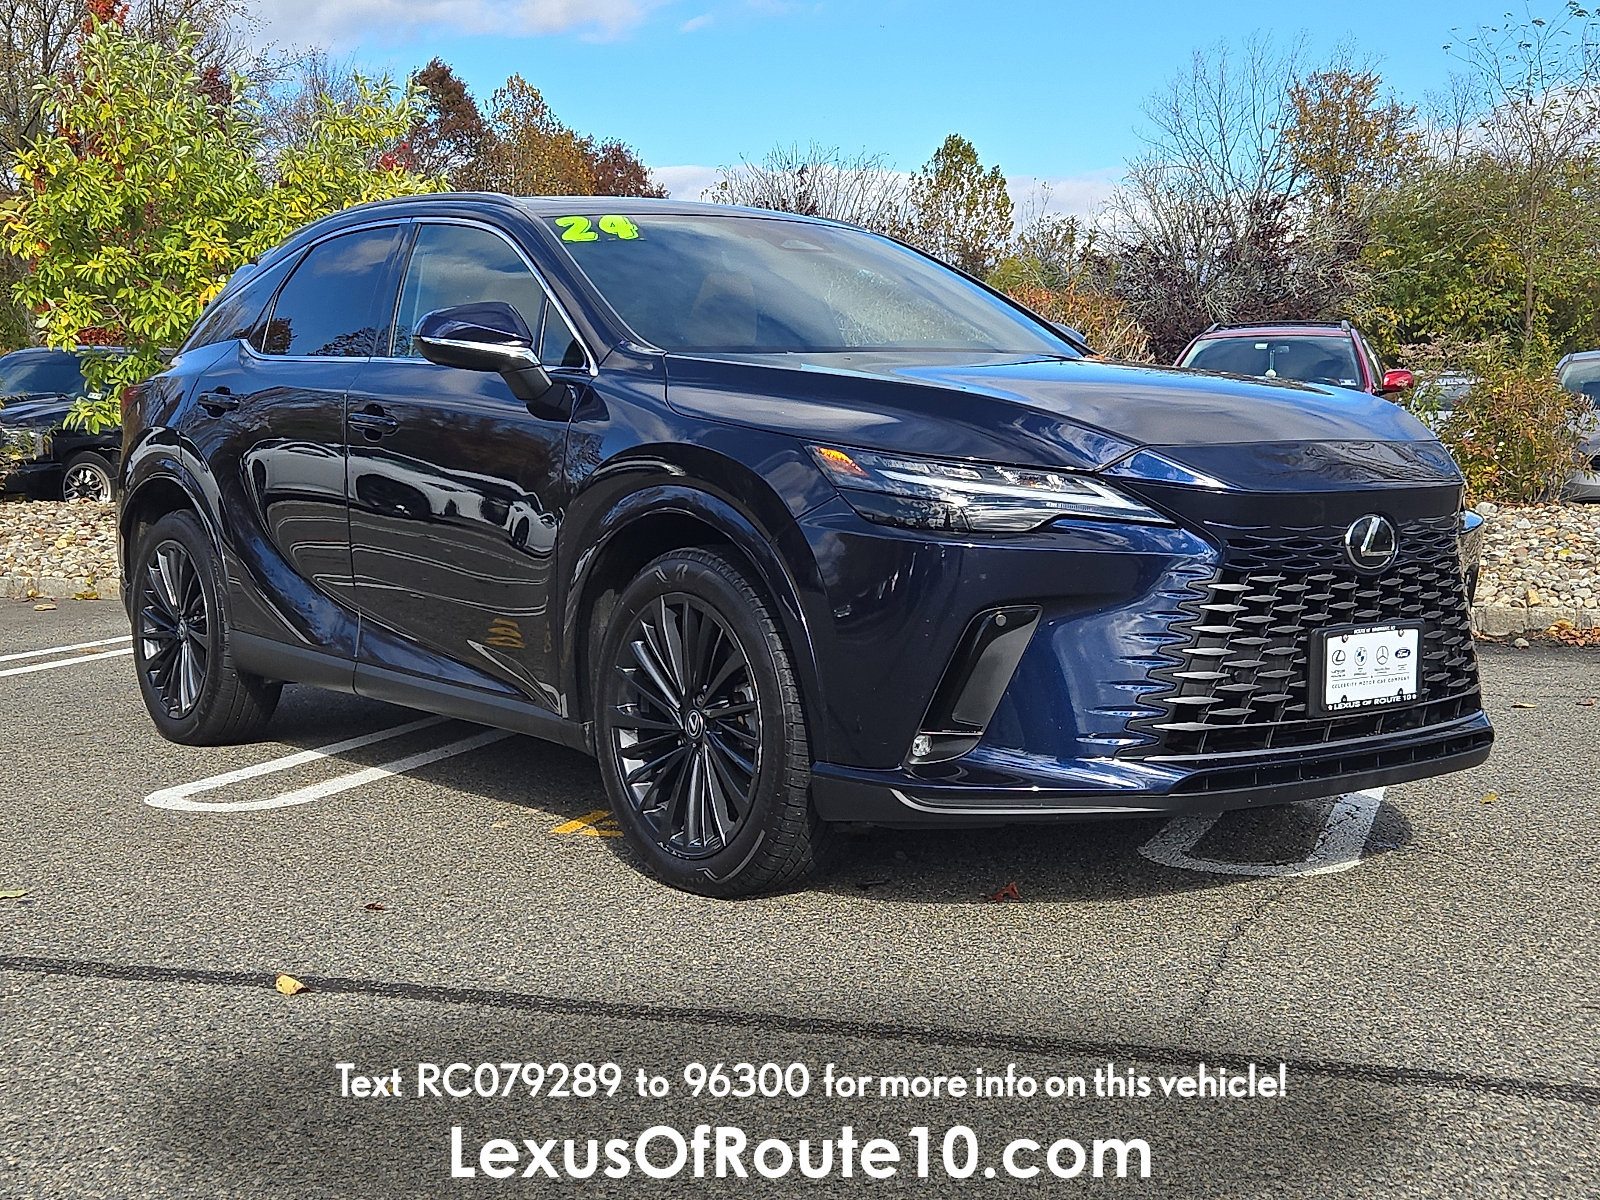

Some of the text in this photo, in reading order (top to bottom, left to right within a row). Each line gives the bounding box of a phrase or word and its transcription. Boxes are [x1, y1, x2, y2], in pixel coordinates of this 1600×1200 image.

[555, 214, 638, 242] 24
[1334, 701, 1361, 710] LEXUS
[1374, 695, 1401, 705] ROUTE
